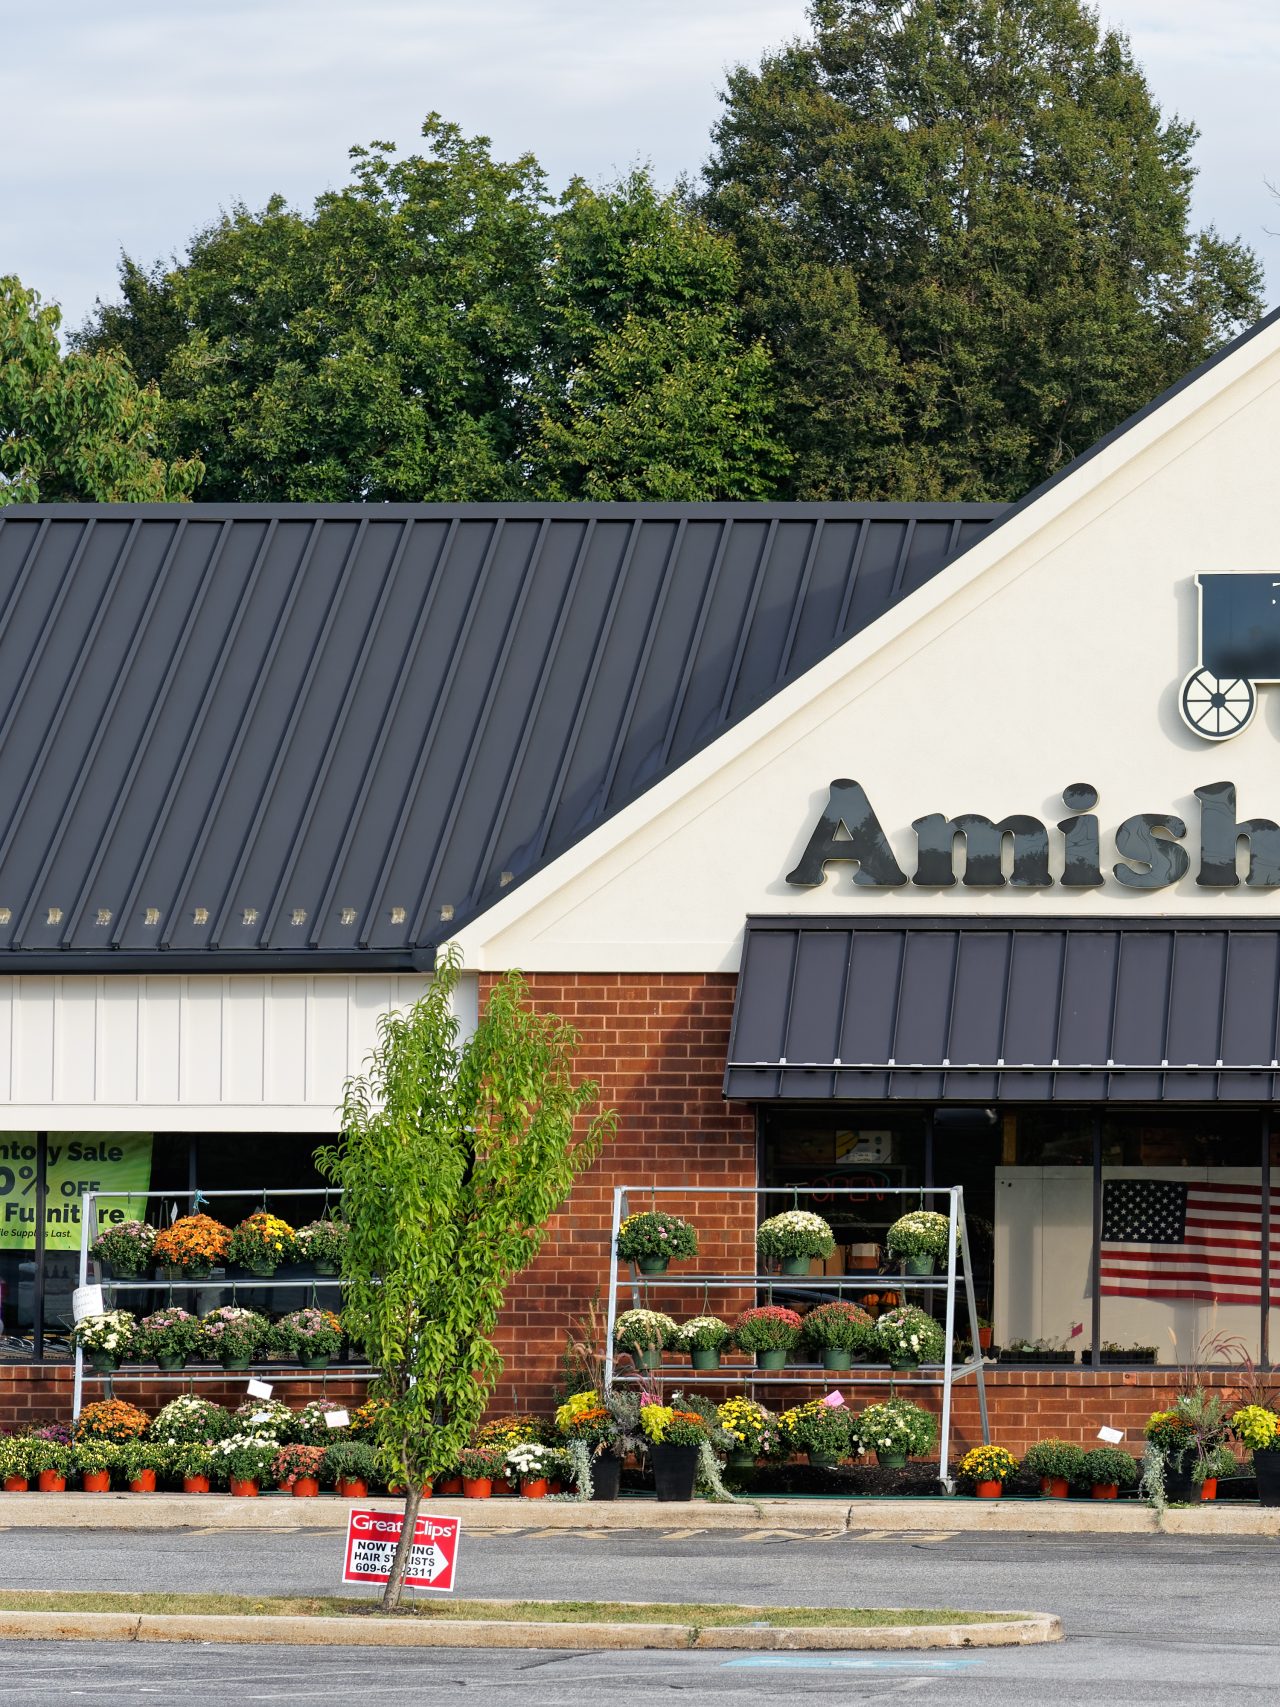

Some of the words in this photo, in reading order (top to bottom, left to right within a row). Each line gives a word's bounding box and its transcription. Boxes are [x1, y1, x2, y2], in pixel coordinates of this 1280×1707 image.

[67, 1141, 124, 1162] Sale
[60, 1180, 101, 1197] OFF
[812, 1176, 885, 1202] OPEN
[5, 1202, 125, 1223] Funitre
[10, 1229, 48, 1239] Suppls
[51, 1230, 72, 1238] Last.
[352, 1514, 403, 1533] Great
[354, 1552, 381, 1562] HAIR
[357, 1541, 387, 1552] NOW
[390, 1544, 434, 1556] HING
